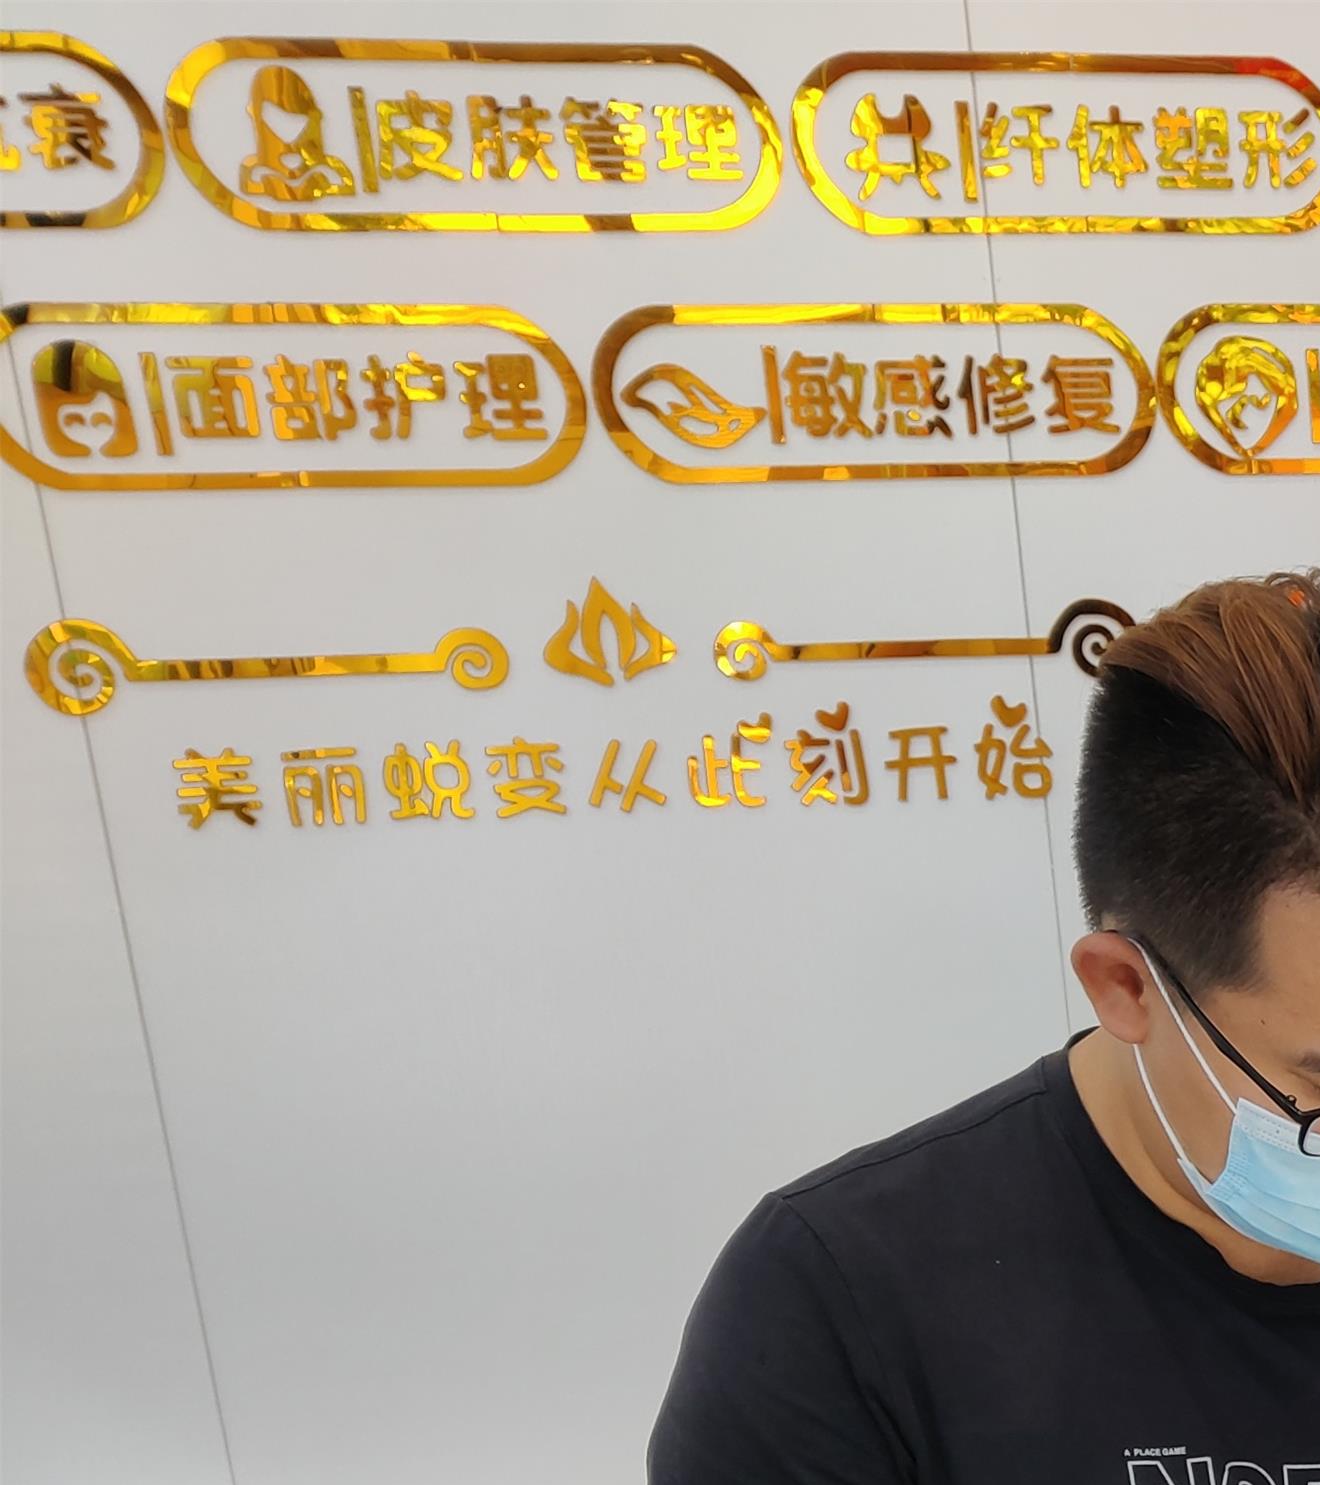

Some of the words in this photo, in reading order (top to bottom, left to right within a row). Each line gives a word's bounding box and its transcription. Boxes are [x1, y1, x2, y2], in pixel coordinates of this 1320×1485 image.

[0, 83, 116, 172] 衰
[376, 90, 744, 184] 皮肤管理
[981, 102, 1319, 191] 纤体塑形
[165, 350, 549, 442] 面部护理
[782, 350, 1122, 440] 敏感修复
[171, 695, 1053, 830] 美丽蜕变从此刻开始
